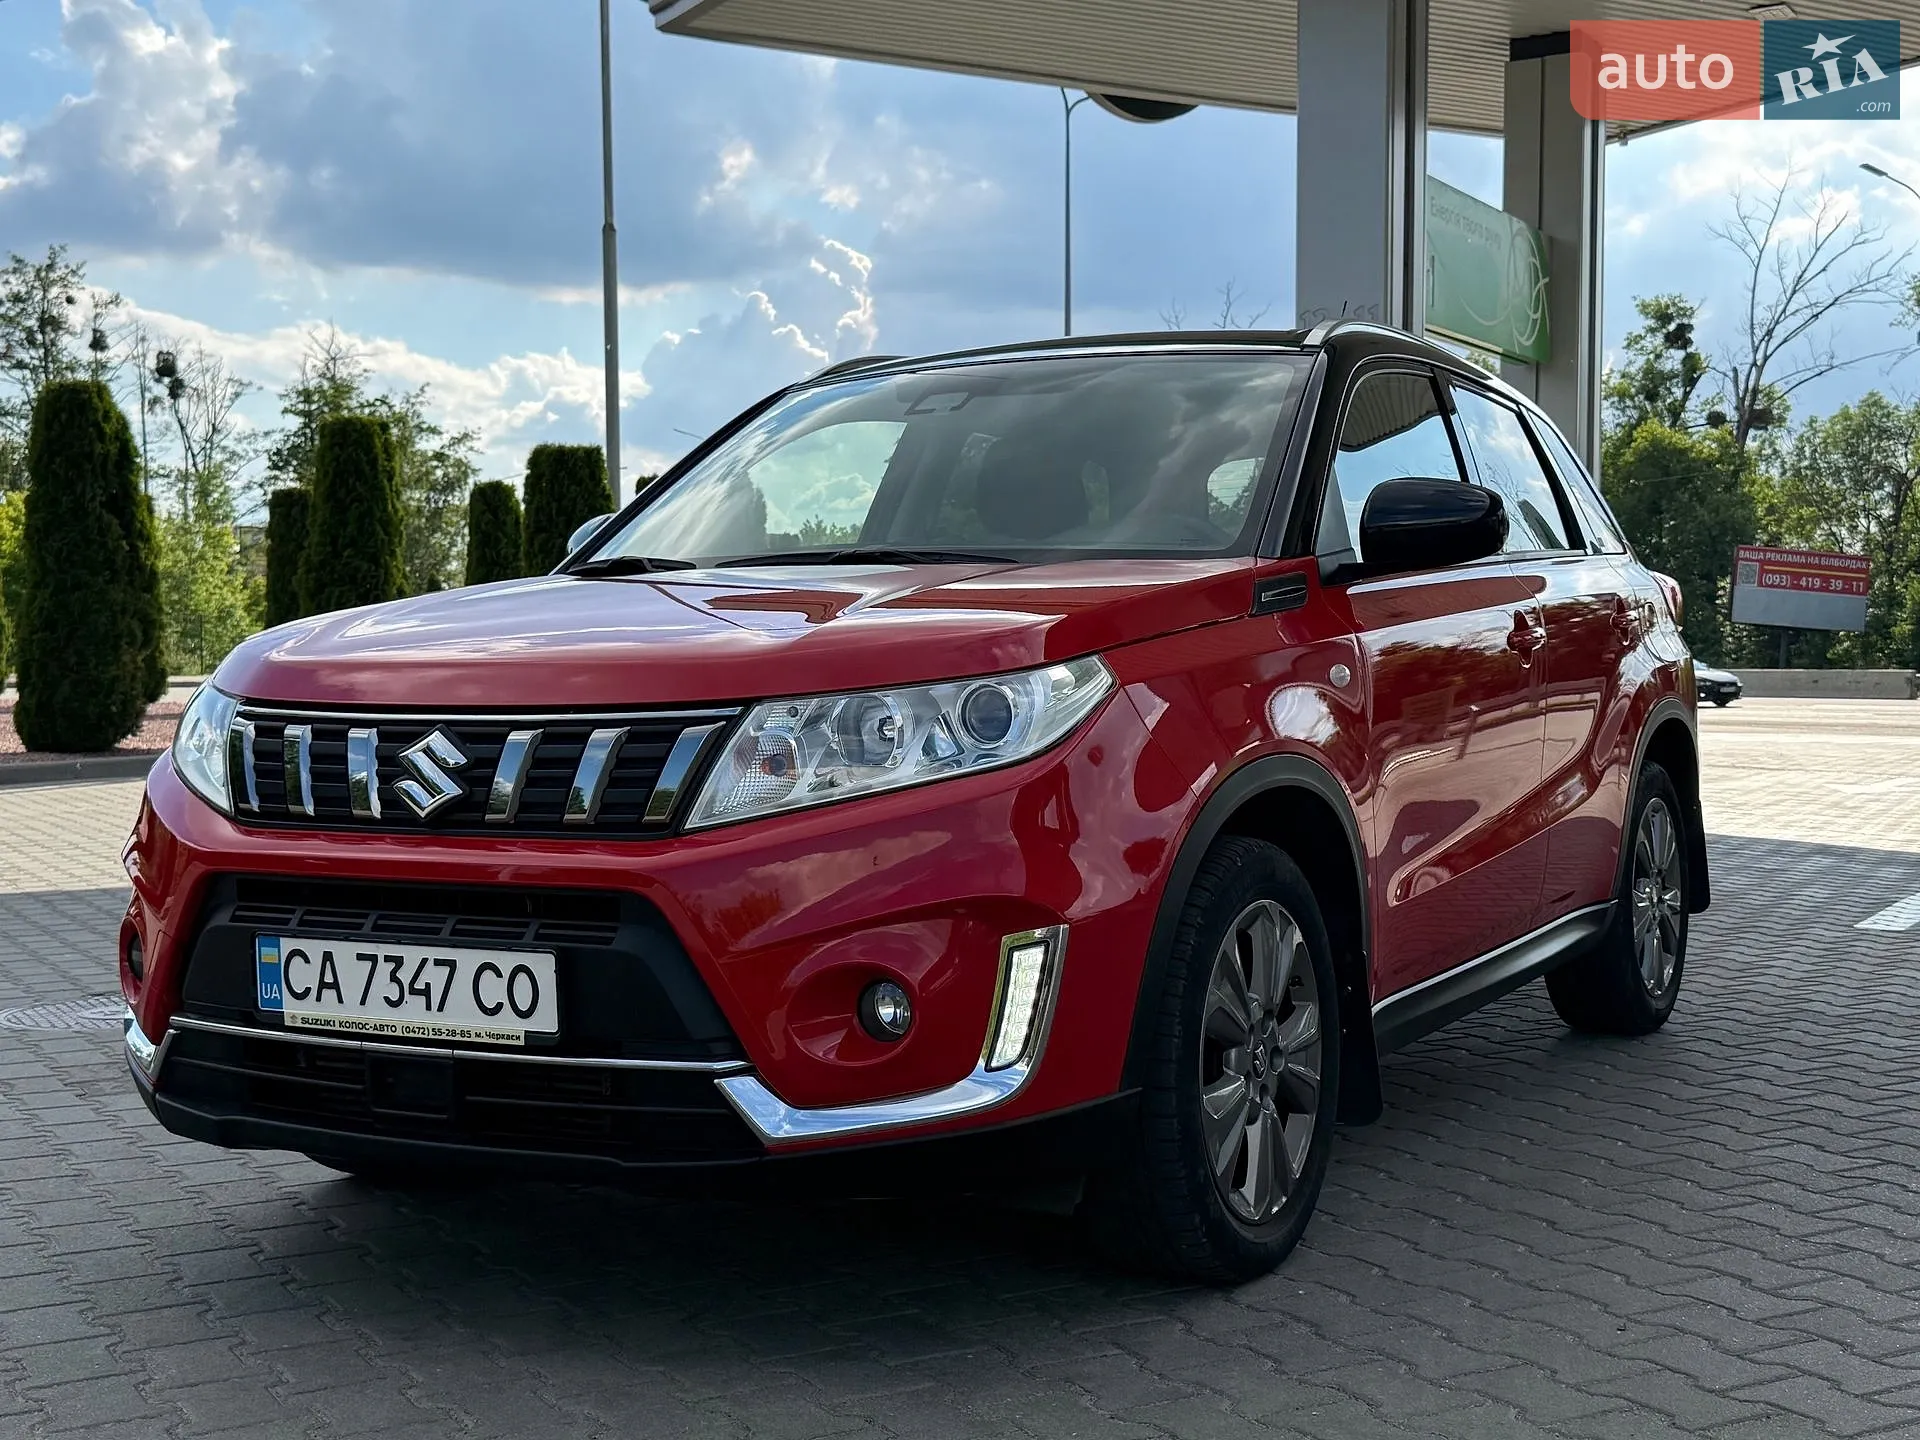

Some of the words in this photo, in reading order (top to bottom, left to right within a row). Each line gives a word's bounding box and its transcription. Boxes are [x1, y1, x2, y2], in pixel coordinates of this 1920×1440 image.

[1739, 550, 1764, 560] ВАША
[1766, 553, 1806, 564] РЕКЛАМА
[1807, 556, 1820, 564] НА
[1820, 558, 1867, 569] БІЛБОРДАХ
[1762, 573, 1791, 587] (093)
[1800, 577, 1820, 588] 419
[1829, 579, 1843, 590] 39
[1852, 581, 1864, 592] 11
[261, 983, 281, 1000] UA
[283, 948, 344, 1005] CA
[356, 952, 458, 1013] 7347
[472, 961, 540, 1020] CO
[300, 1016, 336, 1027] SUZUKI
[401, 1024, 430, 1037] (0472)
[431, 1027, 472, 1039] 55-28-85
